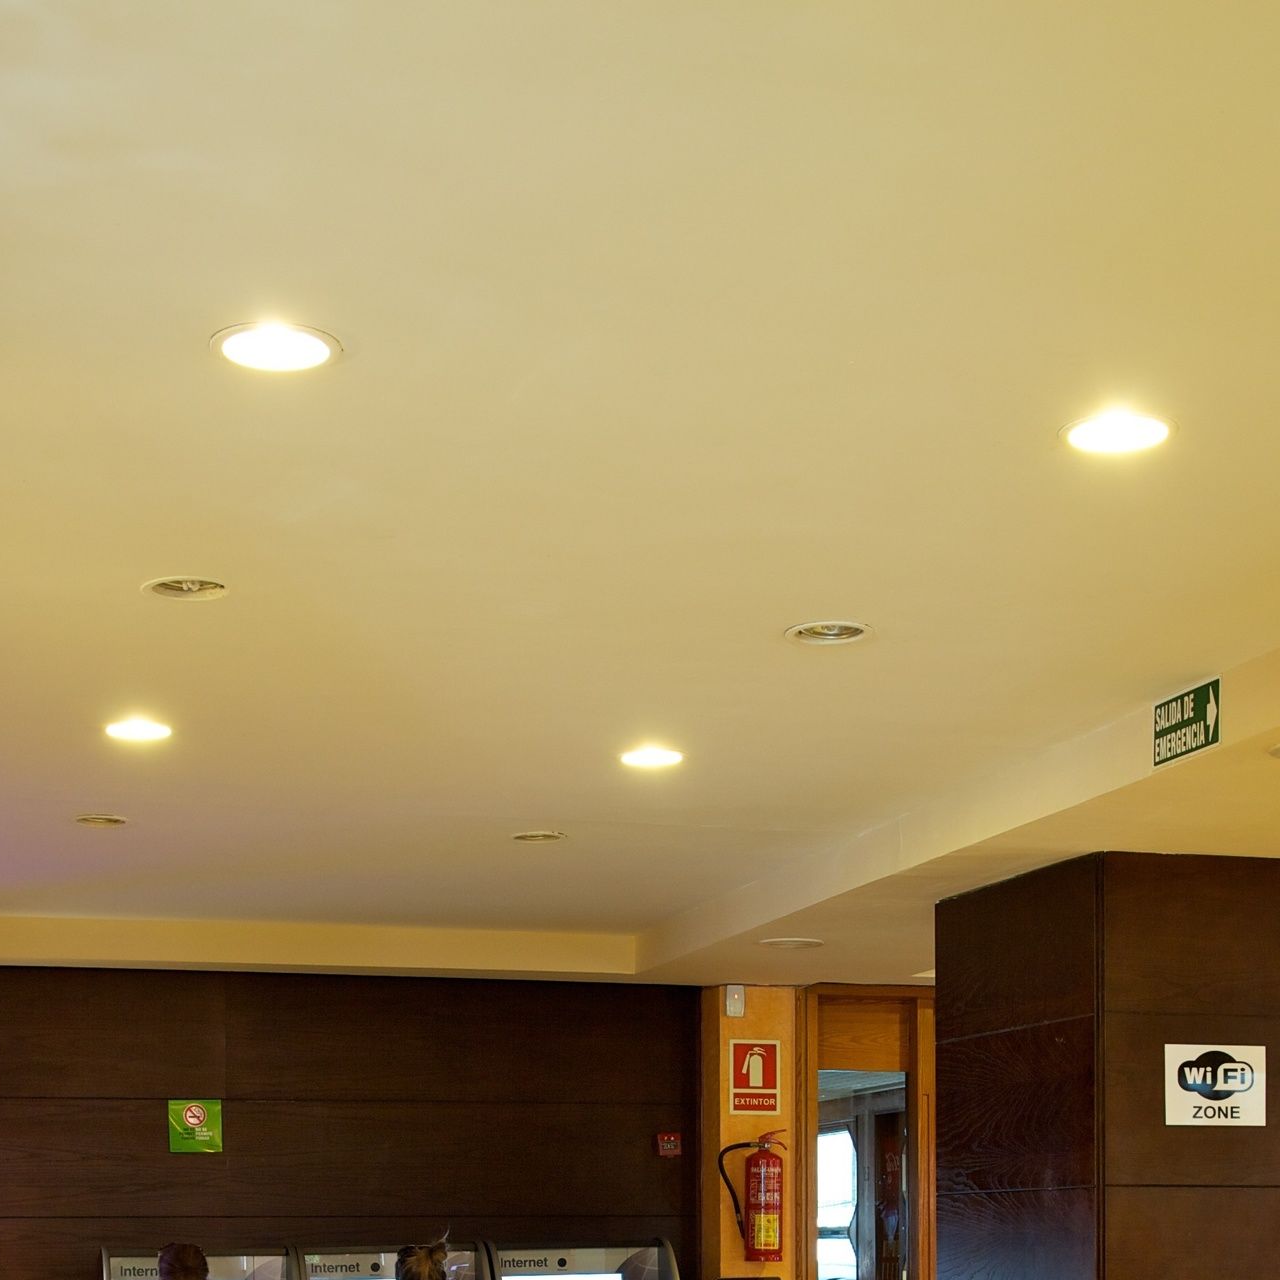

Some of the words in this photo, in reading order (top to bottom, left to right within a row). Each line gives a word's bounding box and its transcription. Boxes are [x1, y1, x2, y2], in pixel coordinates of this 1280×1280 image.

[1155, 699, 1182, 732] SALIDA
[1183, 693, 1194, 720] DE
[1155, 720, 1206, 763] EMERGENCIA
[734, 1097, 776, 1106] EXTINTOR
[1192, 1106, 1240, 1119] ZONE
[311, 1262, 361, 1274] Internet
[501, 1257, 549, 1268] Internet
[120, 1265, 159, 1277] Intern
